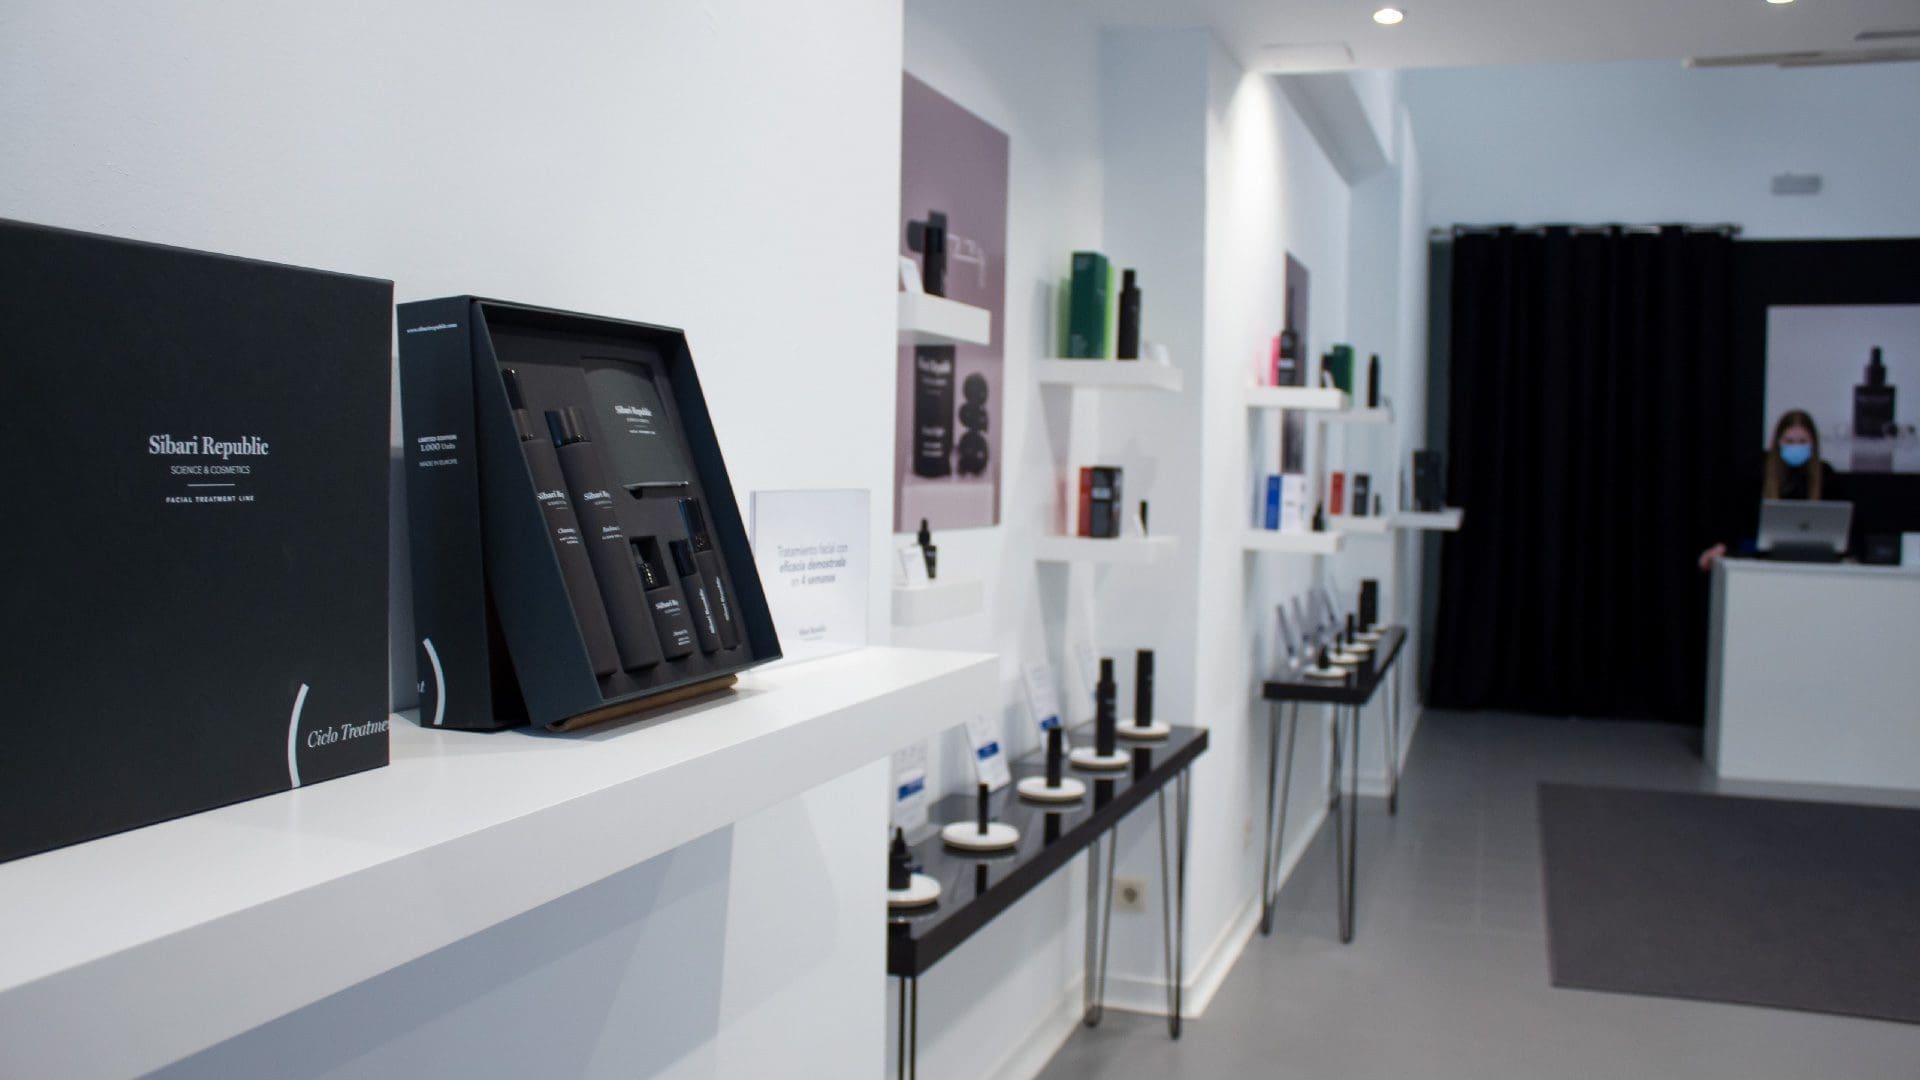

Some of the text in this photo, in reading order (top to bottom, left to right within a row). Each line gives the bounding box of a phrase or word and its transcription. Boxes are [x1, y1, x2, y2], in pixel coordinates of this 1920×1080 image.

[149, 434, 269, 460] Sibari Republic
[170, 465, 250, 475] SCIENCE & COSMETICS
[195, 495, 236, 503] TREATMENT
[307, 726, 339, 748] Ciclo
